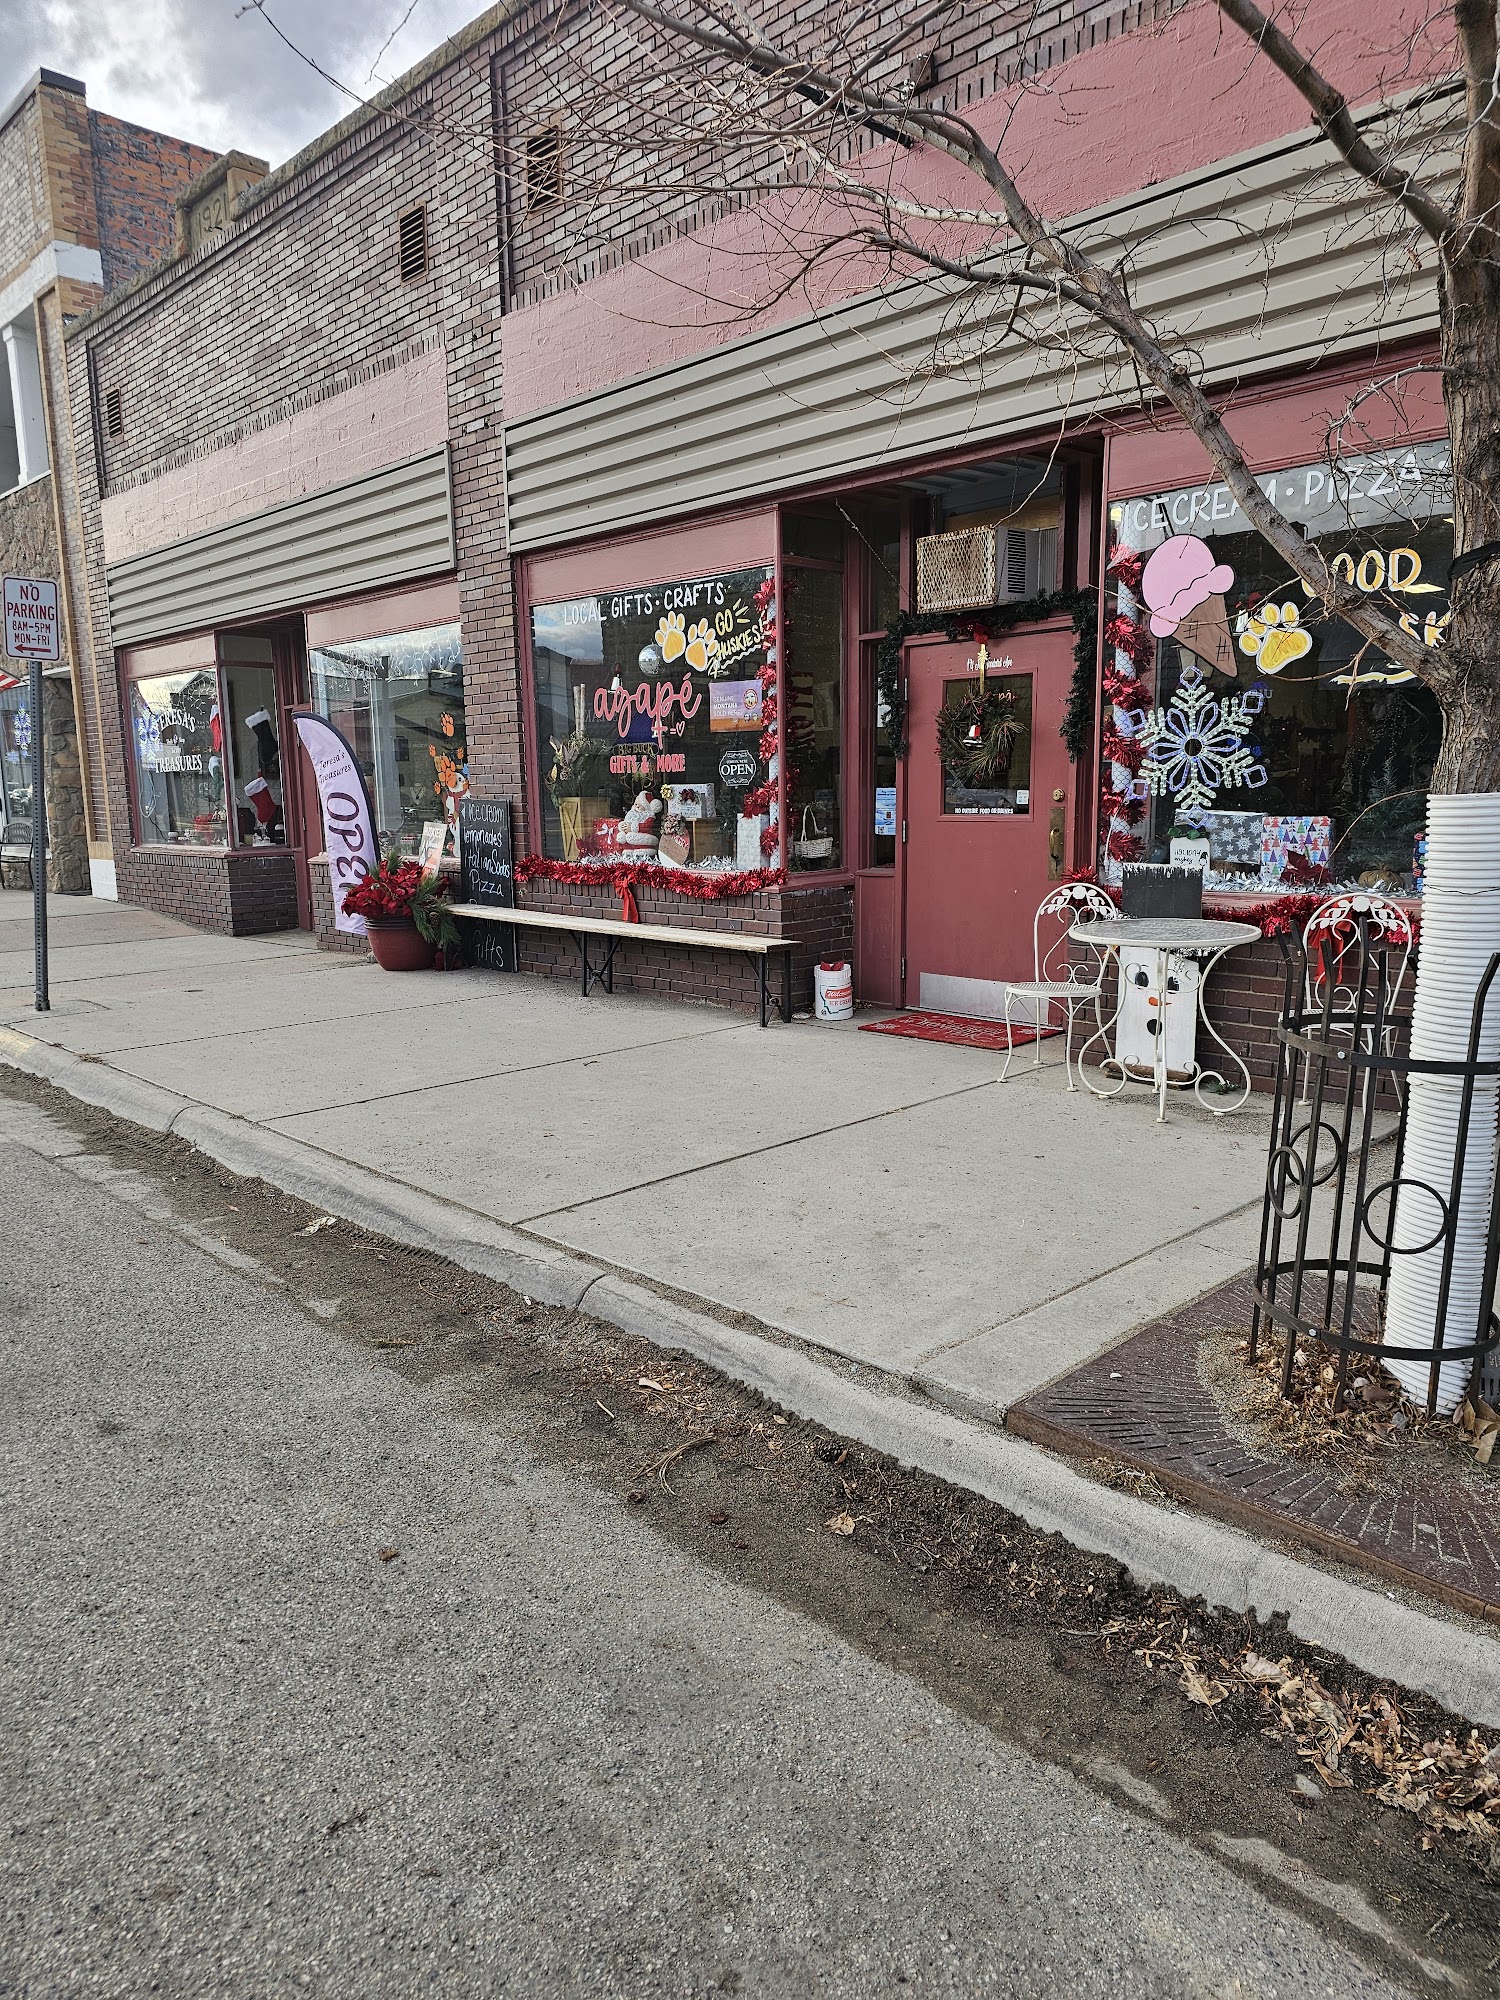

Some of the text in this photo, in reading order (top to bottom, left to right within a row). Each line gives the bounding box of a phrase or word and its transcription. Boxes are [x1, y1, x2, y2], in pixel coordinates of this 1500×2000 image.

[199, 192, 227, 239] 1921
[1305, 453, 1422, 505] PIZZA
[1302, 548, 1422, 598] OOD
[20, 585, 40, 601] NO
[564, 581, 725, 626] LOCAL GIFTS CRAFTS
[7, 602, 55, 621] PARKING
[715, 608, 734, 636] GO
[12, 620, 51, 634] 8AM-5PM
[14, 632, 50, 645] MON-FRI
[593, 672, 703, 750] agapé
[154, 753, 203, 775] TREASURES
[319, 750, 345, 772] Teresa's
[609, 753, 686, 774] GIFTS & MORE
[721, 763, 754, 776] OPEN
[318, 764, 353, 785] Treasures
[469, 869, 504, 898] Pizza
